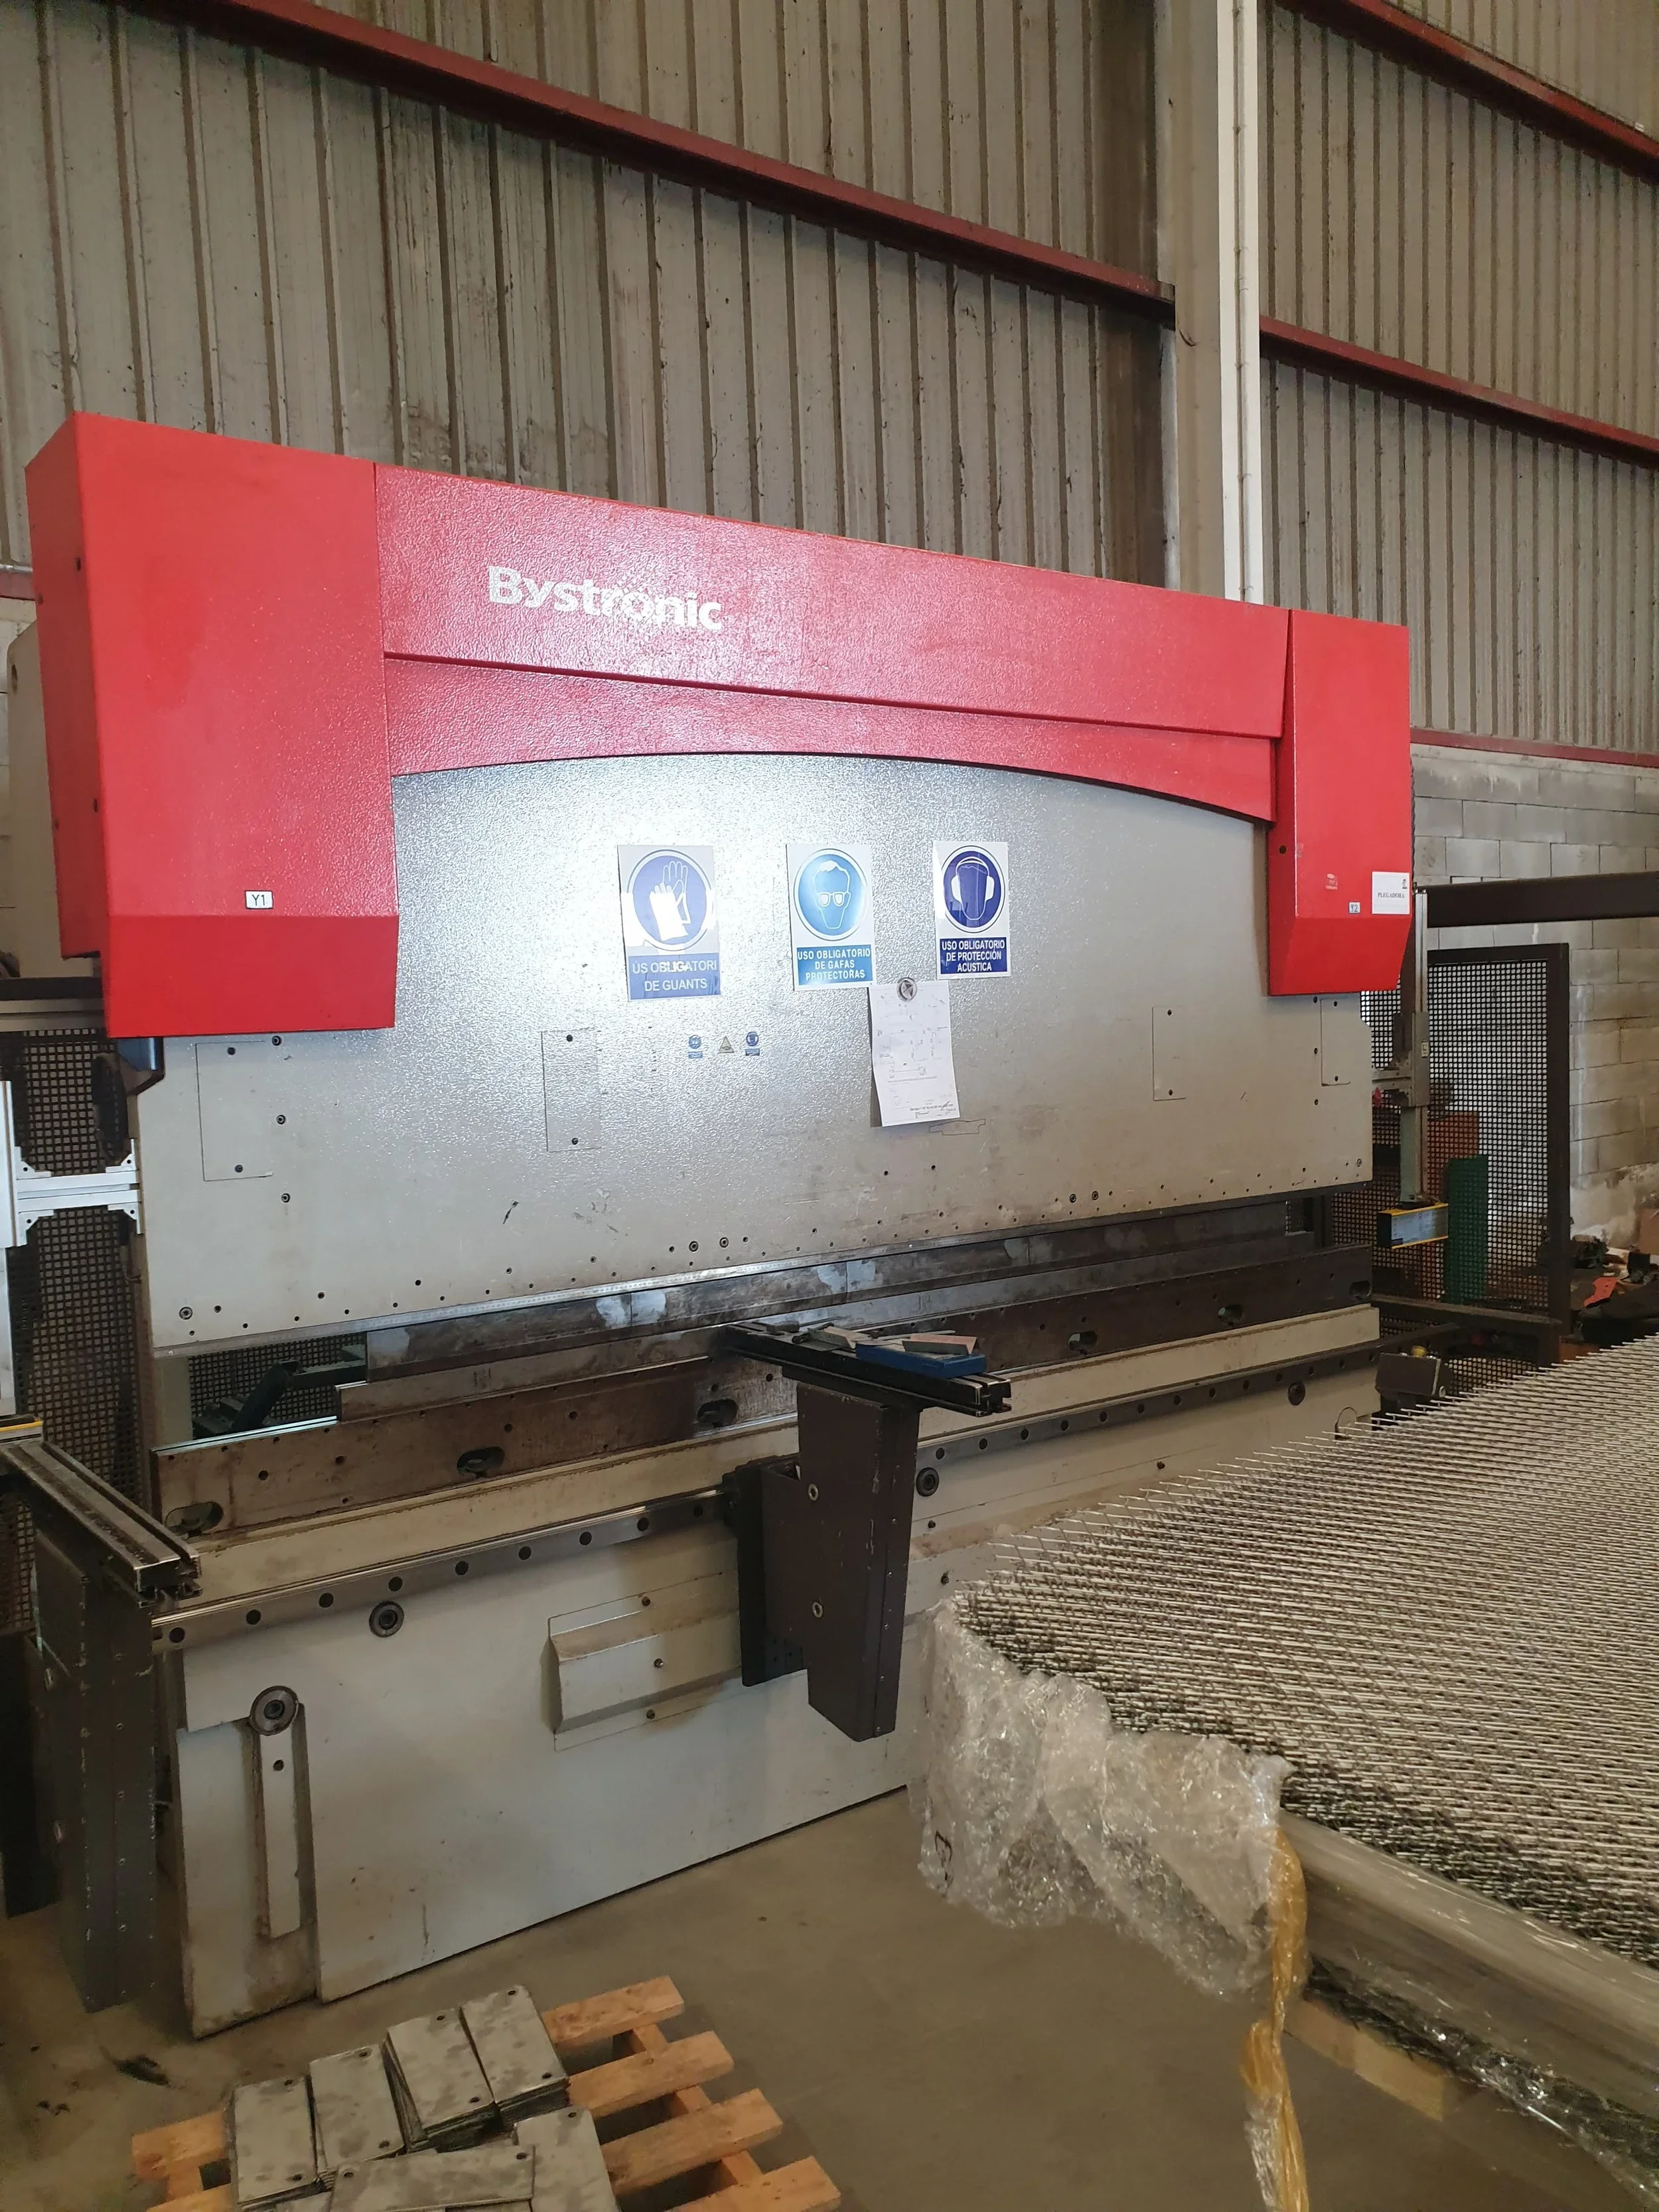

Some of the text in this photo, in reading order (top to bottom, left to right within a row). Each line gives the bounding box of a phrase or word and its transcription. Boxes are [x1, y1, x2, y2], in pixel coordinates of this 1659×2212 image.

[488, 566, 722, 631] Bystronic
[252, 895, 265, 906] Y1
[942, 940, 1005, 950] USO OBLIGATORIO
[798, 948, 871, 960] USO OBLIGATORIO
[946, 948, 1001, 962] DE PROTECCIÓN
[650, 960, 717, 973] OBLIGATORI
[815, 960, 855, 970] DE GAFAS
[957, 962, 992, 972] ACUSTICA
[806, 969, 865, 981] PROTECTORAS
[644, 978, 707, 992] DE GUANTS
